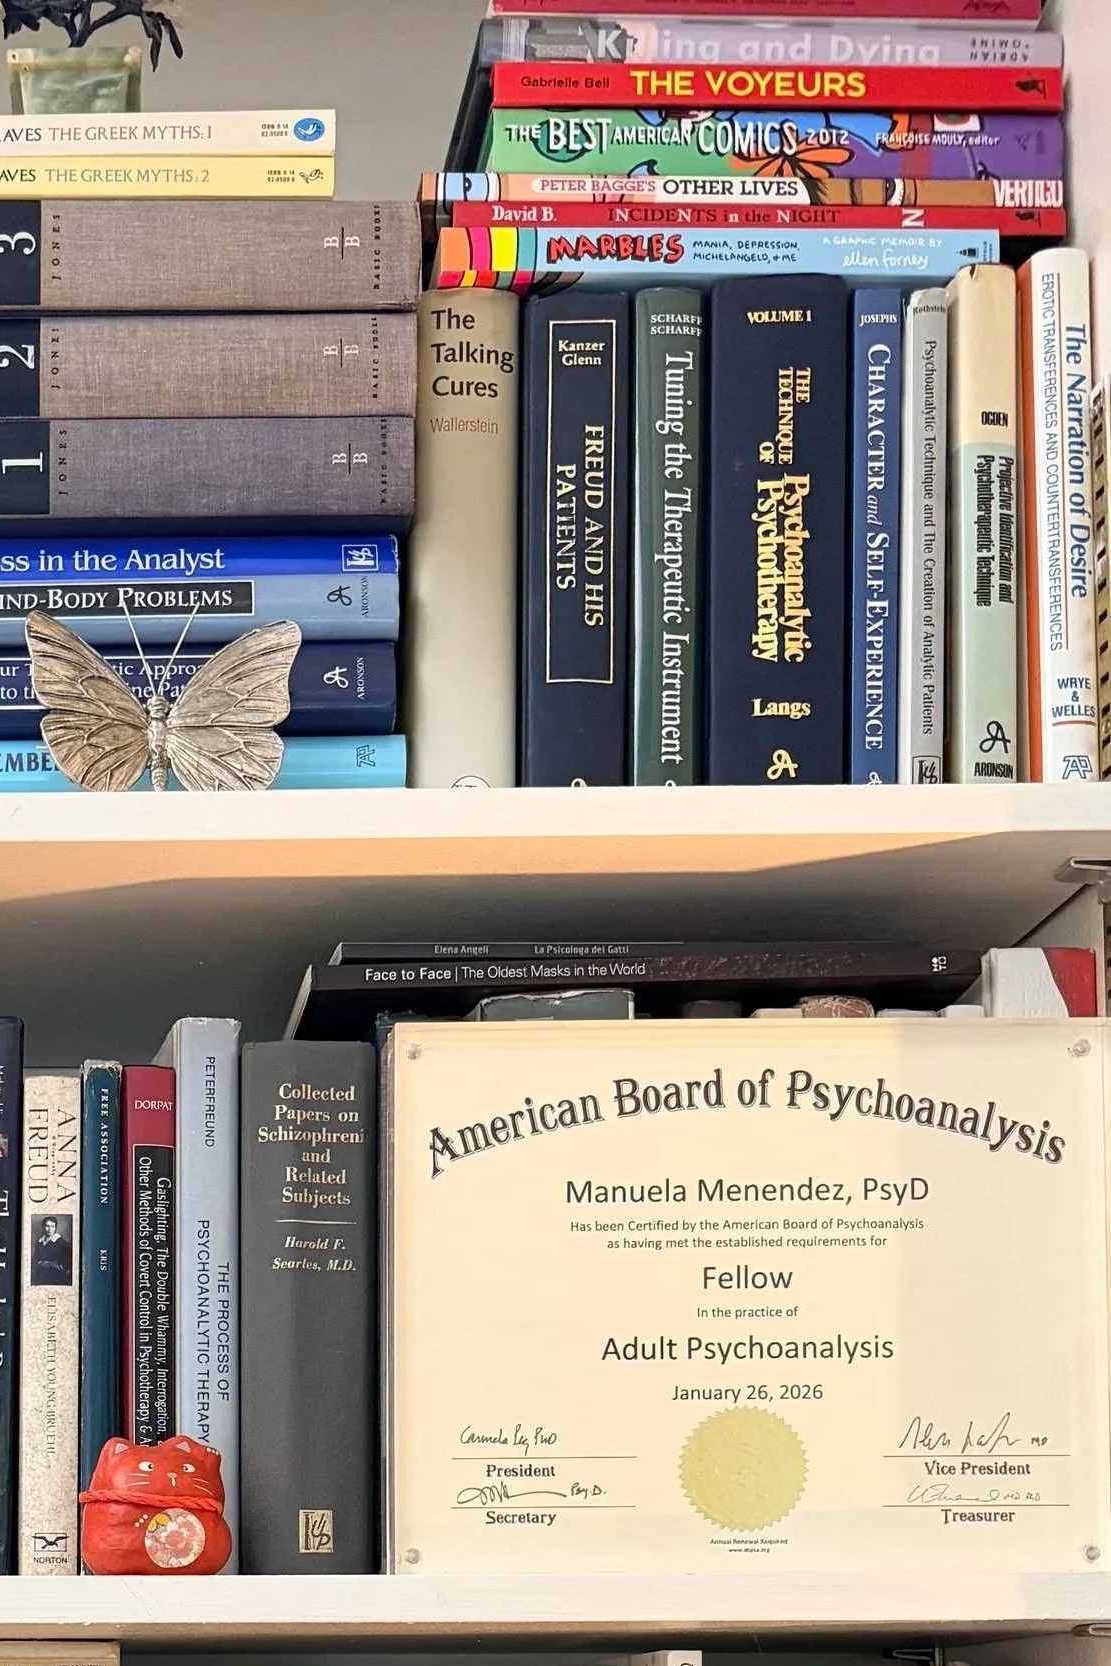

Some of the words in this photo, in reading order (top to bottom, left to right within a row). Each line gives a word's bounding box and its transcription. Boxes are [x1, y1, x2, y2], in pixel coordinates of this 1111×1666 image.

[520, 76, 580, 89] Gabrielle
[585, 77, 610, 89] Bell
[631, 71, 703, 97] THE
[712, 72, 866, 98] VOYEURS
[506, 125, 542, 140] THE
[549, 118, 610, 154] BEST
[612, 126, 693, 147] AMERICAN
[697, 120, 797, 155] COMICS
[806, 129, 849, 145] 2012
[541, 178, 587, 193] PETER
[591, 179, 656, 194] BAGGE'S
[663, 179, 735, 196] OTHER
[740, 180, 798, 196] LIVES
[492, 205, 537, 222] David
[541, 206, 557, 222] B.
[547, 234, 683, 264] MARBLES
[432, 309, 475, 330] The
[746, 310, 800, 324] VOLUME
[806, 310, 812, 323] 1
[431, 342, 514, 373] Talking
[432, 376, 498, 398] Cures
[1, 452, 44, 473] 1
[38, 552, 64, 572] in
[71, 550, 116, 572] the
[125, 548, 225, 574] Analyst
[116, 586, 233, 608] PROBLEMS
[752, 698, 811, 720] Langs
[365, 969, 396, 981] Face
[401, 969, 415, 980] to
[419, 968, 451, 980] Face
[461, 967, 484, 979] The
[487, 966, 527, 979] Oldest
[531, 965, 570, 977] Masks
[574, 964, 585, 976] in
[587, 964, 607, 976] the
[609, 963, 645, 975] World
[427, 1095, 602, 1178] American
[612, 1068, 725, 1118] Board
[737, 1067, 775, 1108] of
[786, 1068, 1067, 1166] Psychoanalysis
[566, 1179, 687, 1204] Manuela
[697, 1178, 853, 1204] Menendez,
[863, 1177, 929, 1205] PsyD
[703, 1265, 793, 1289] Fellow
[697, 1307, 709, 1318] In
[712, 1307, 731, 1318] the
[735, 1307, 782, 1319] practice
[786, 1306, 798, 1317] of
[601, 1336, 677, 1361] Adult
[687, 1334, 894, 1365] Psychoanalysis
[672, 1386, 741, 1403] January
[747, 1385, 773, 1402] 26,
[779, 1384, 823, 1400] 2026
[486, 1465, 556, 1478] President
[924, 1462, 957, 1475] Vice
[962, 1461, 1031, 1476] President
[485, 1511, 556, 1526] Secretary
[941, 1509, 1016, 1523] Treasurer
